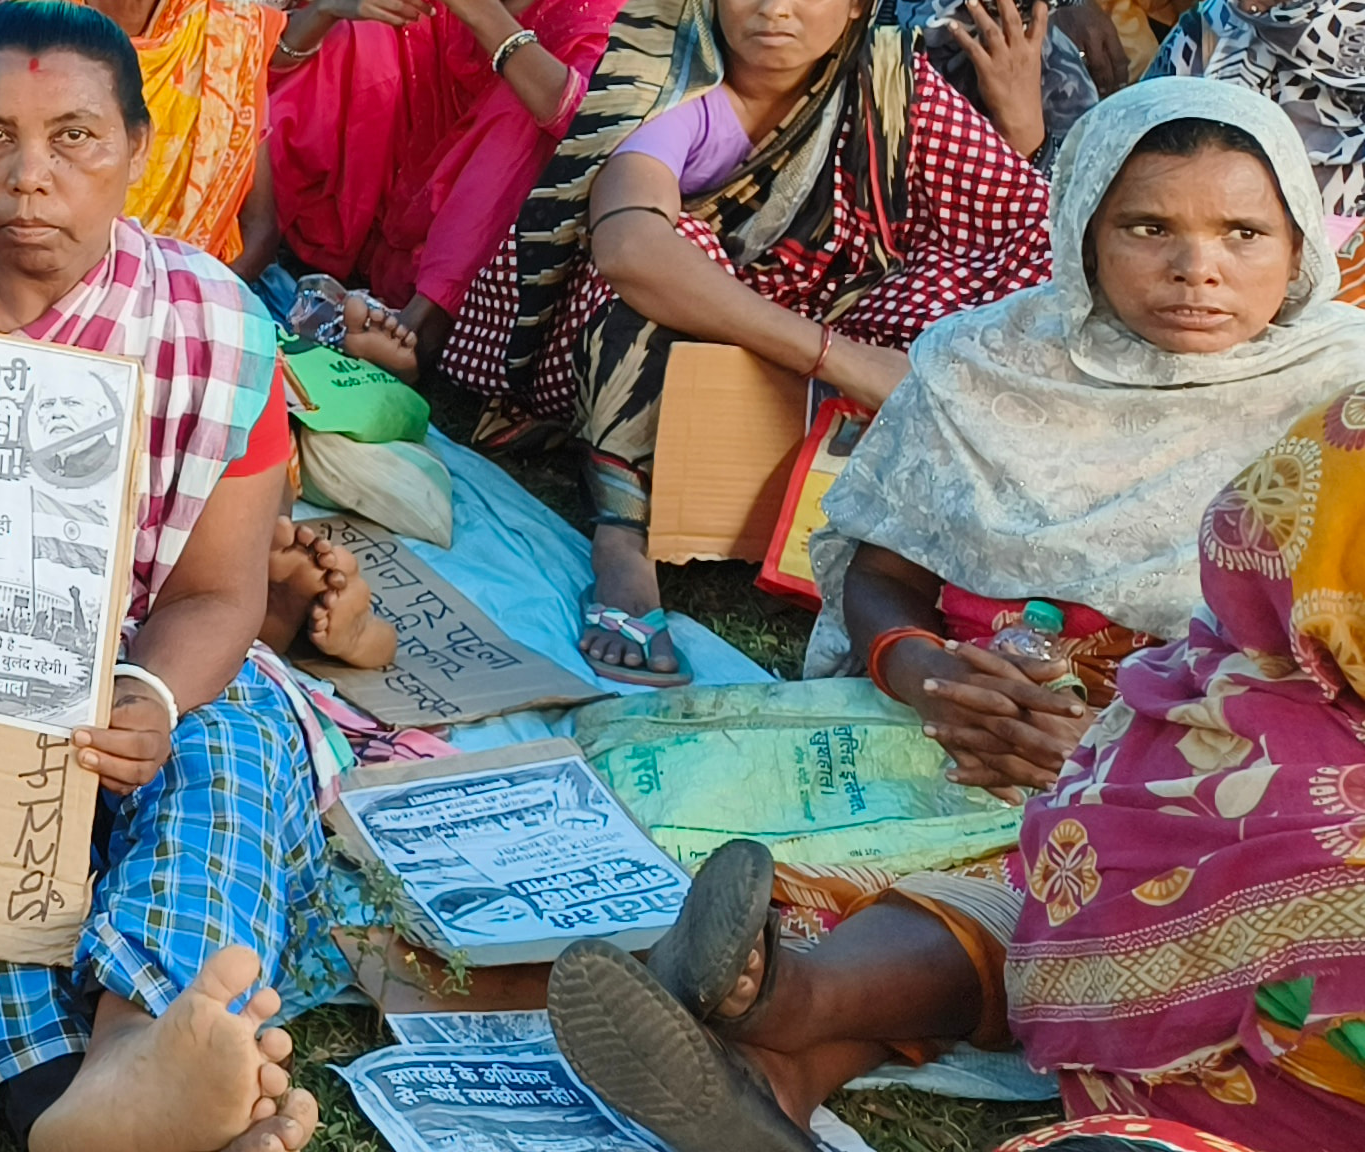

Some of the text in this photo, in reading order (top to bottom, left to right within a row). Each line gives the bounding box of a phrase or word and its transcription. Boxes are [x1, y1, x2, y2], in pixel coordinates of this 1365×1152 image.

[407, 590, 455, 630] पर
[7, 637, 16, 652] है
[2, 654, 31, 671] बुलंद
[34, 657, 68, 676] रहेगी।
[382, 1063, 557, 1086] झारखंड के अधिकार
